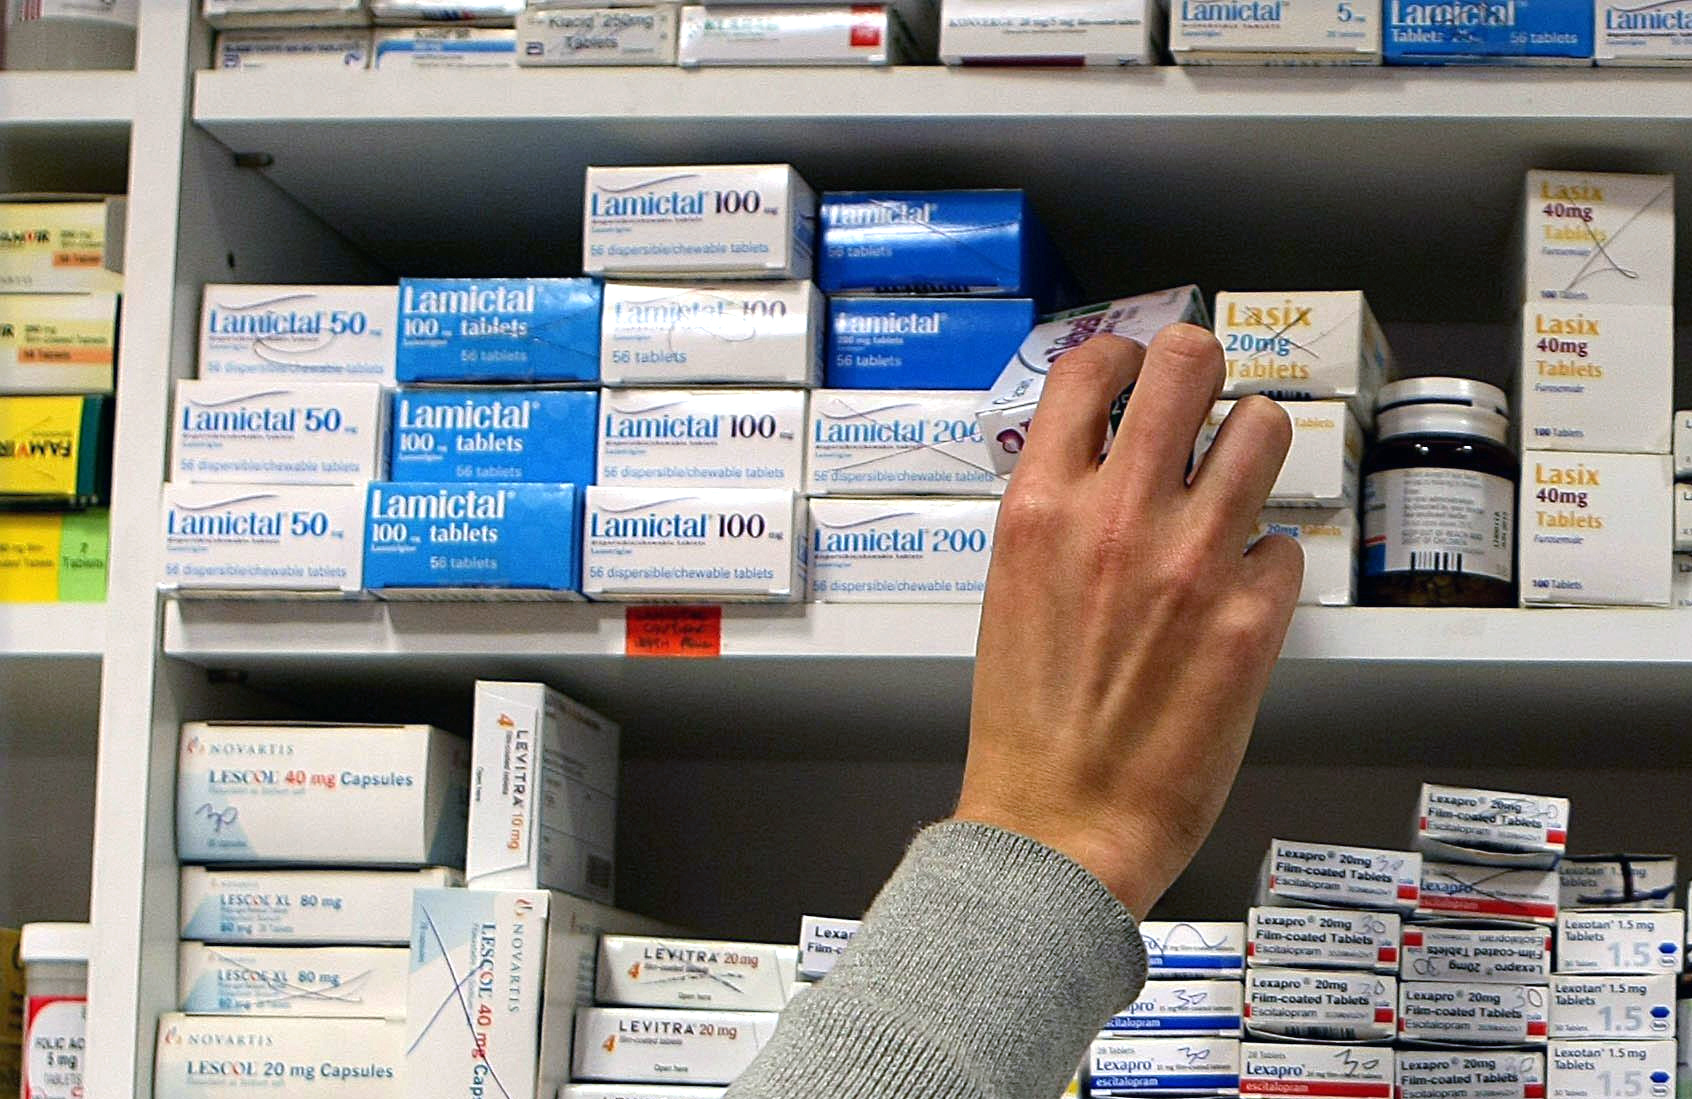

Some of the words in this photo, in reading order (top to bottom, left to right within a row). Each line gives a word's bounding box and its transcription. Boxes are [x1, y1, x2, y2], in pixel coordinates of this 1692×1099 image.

[591, 190, 705, 217] Lamictal
[715, 190, 760, 214] 100
[730, 242, 769, 253] tablets
[1227, 302, 1312, 328] Lasix
[1536, 314, 1600, 337] Lasix
[1226, 335, 1290, 355] 20mg
[1537, 338, 1588, 356] 40mg
[613, 350, 631, 363] 56
[635, 349, 687, 363] tablets
[1227, 361, 1309, 380] Tablets
[1536, 360, 1602, 379] Tablets
[183, 407, 296, 432] Lamictal
[304, 409, 340, 431] 50
[401, 402, 530, 428] Lamictal
[401, 435, 439, 451] 100
[457, 435, 523, 452] tablets
[591, 513, 707, 538] Lamictal
[718, 514, 765, 538] 100
[210, 743, 294, 756] NOVARTIS
[209, 769, 279, 787] LESCOL
[285, 770, 306, 786] 40
[311, 772, 335, 790] mg
[341, 770, 414, 789] Capsules
[1257, 915, 1307, 929] Lexapro
[1320, 918, 1352, 931] 20mg
[1565, 918, 1608, 932] Lexotan
[1618, 919, 1633, 930] 1.5
[1635, 921, 1654, 932] mg
[1256, 931, 1327, 943] Film-coated
[1331, 933, 1373, 945] Tablets
[1565, 930, 1604, 942] Tablets
[1606, 942, 1651, 968] 1.5
[509, 920, 524, 1013] NOVARTIS
[620, 1020, 694, 1035] LEVITRA
[700, 1024, 715, 1036] 20
[718, 1026, 737, 1039] mg
